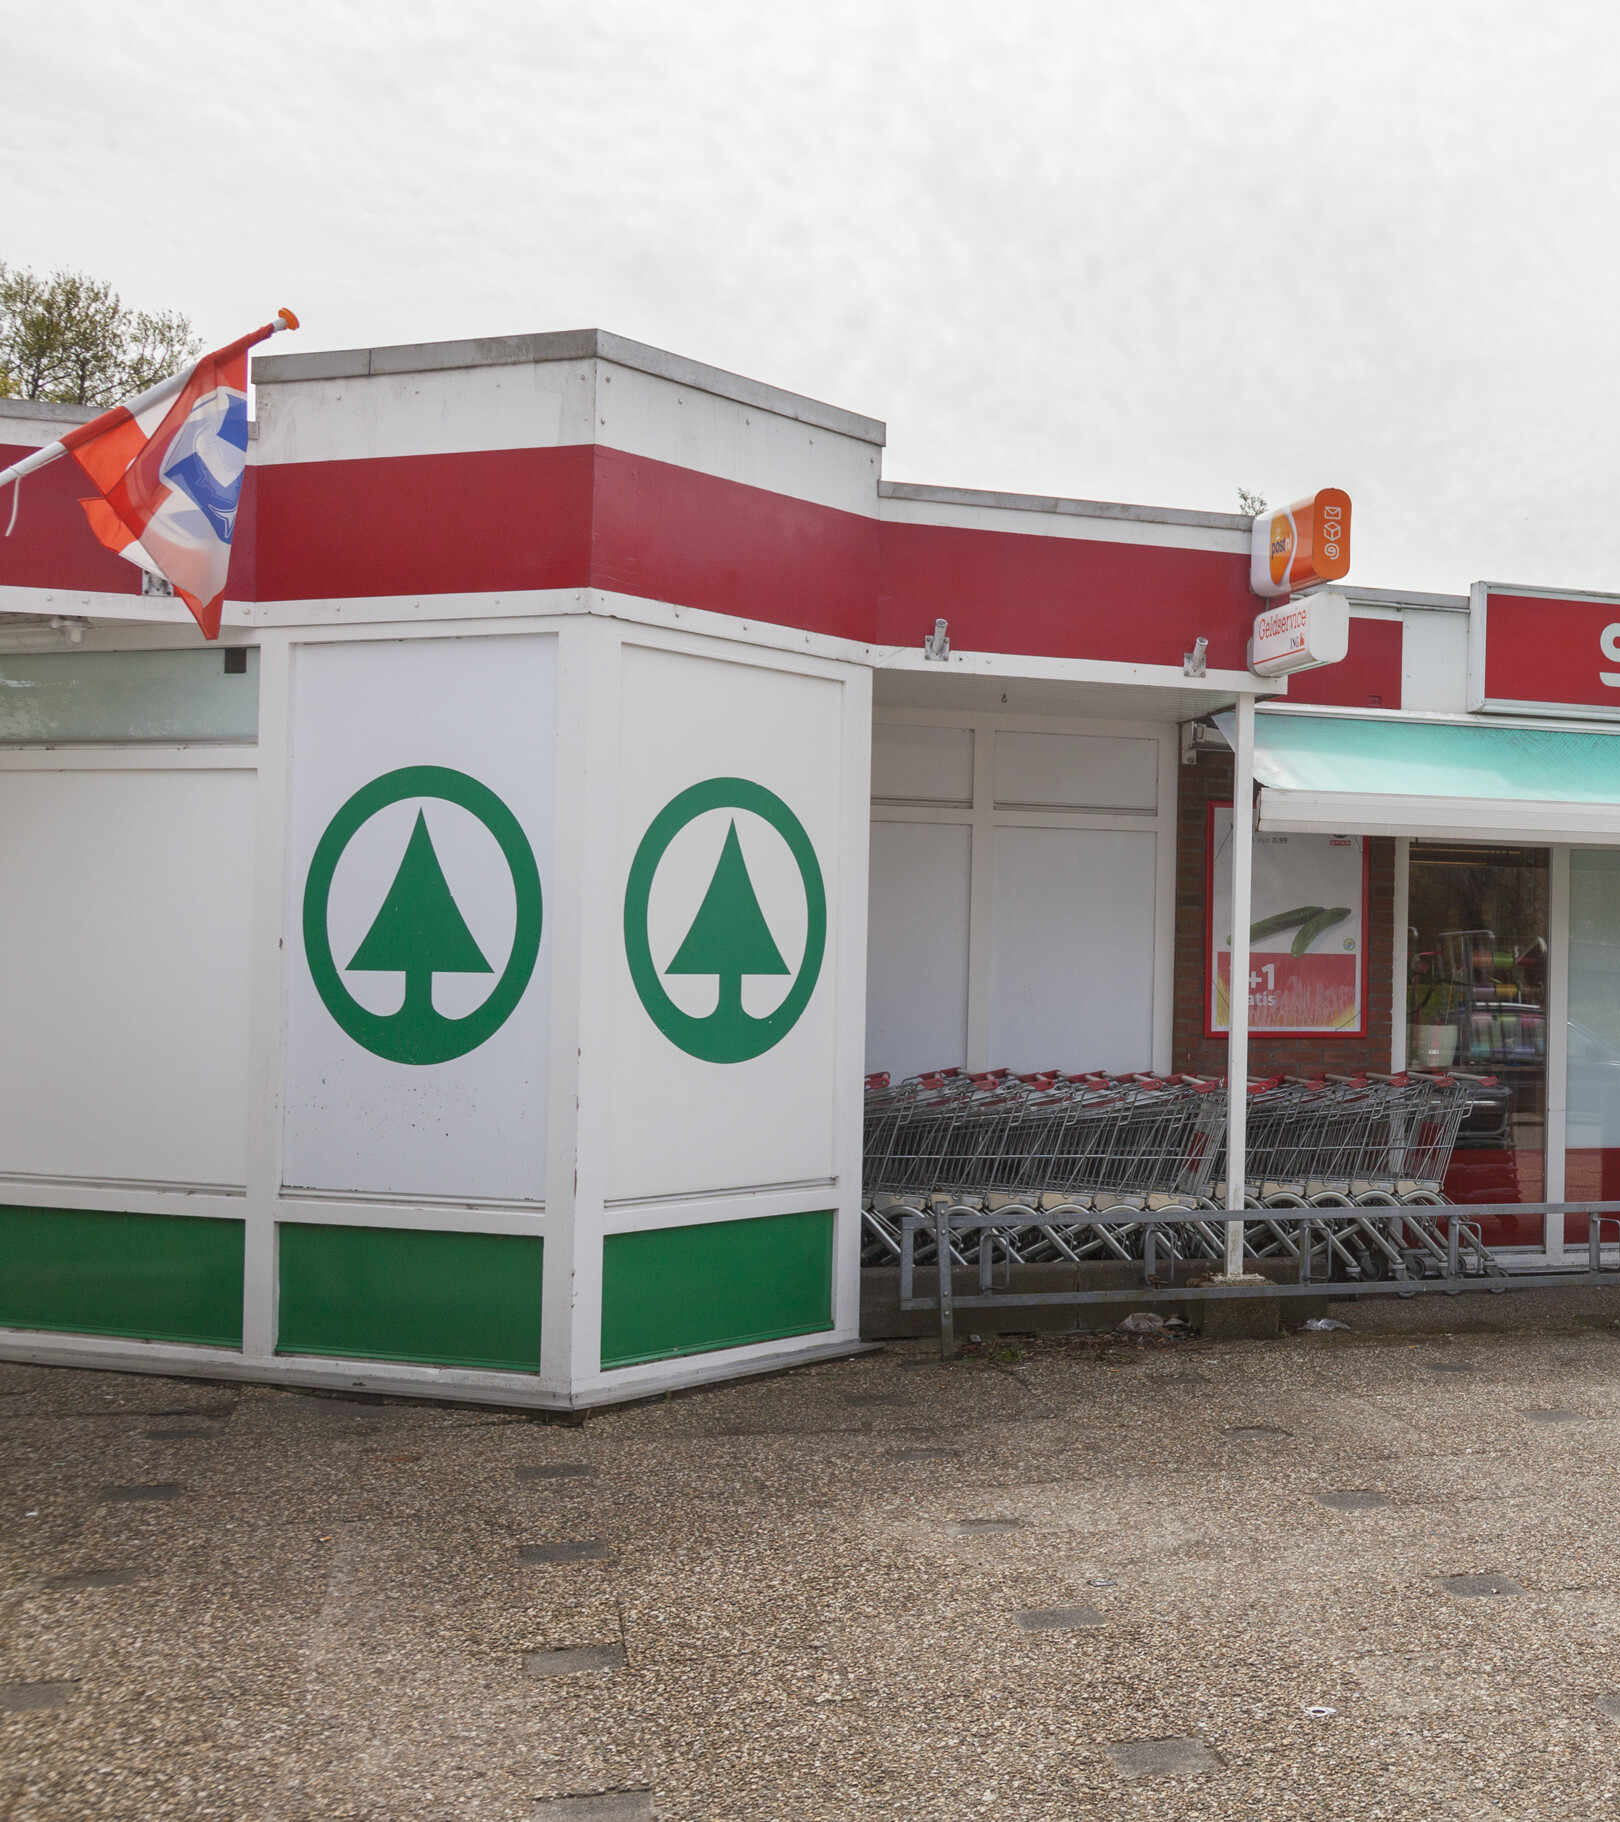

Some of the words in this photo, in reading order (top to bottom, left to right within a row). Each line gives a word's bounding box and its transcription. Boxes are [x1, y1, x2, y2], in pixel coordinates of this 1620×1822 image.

[1259, 607, 1306, 640] Geldservice
[1290, 636, 1300, 649] ING
[1248, 991, 1275, 1006] atis
